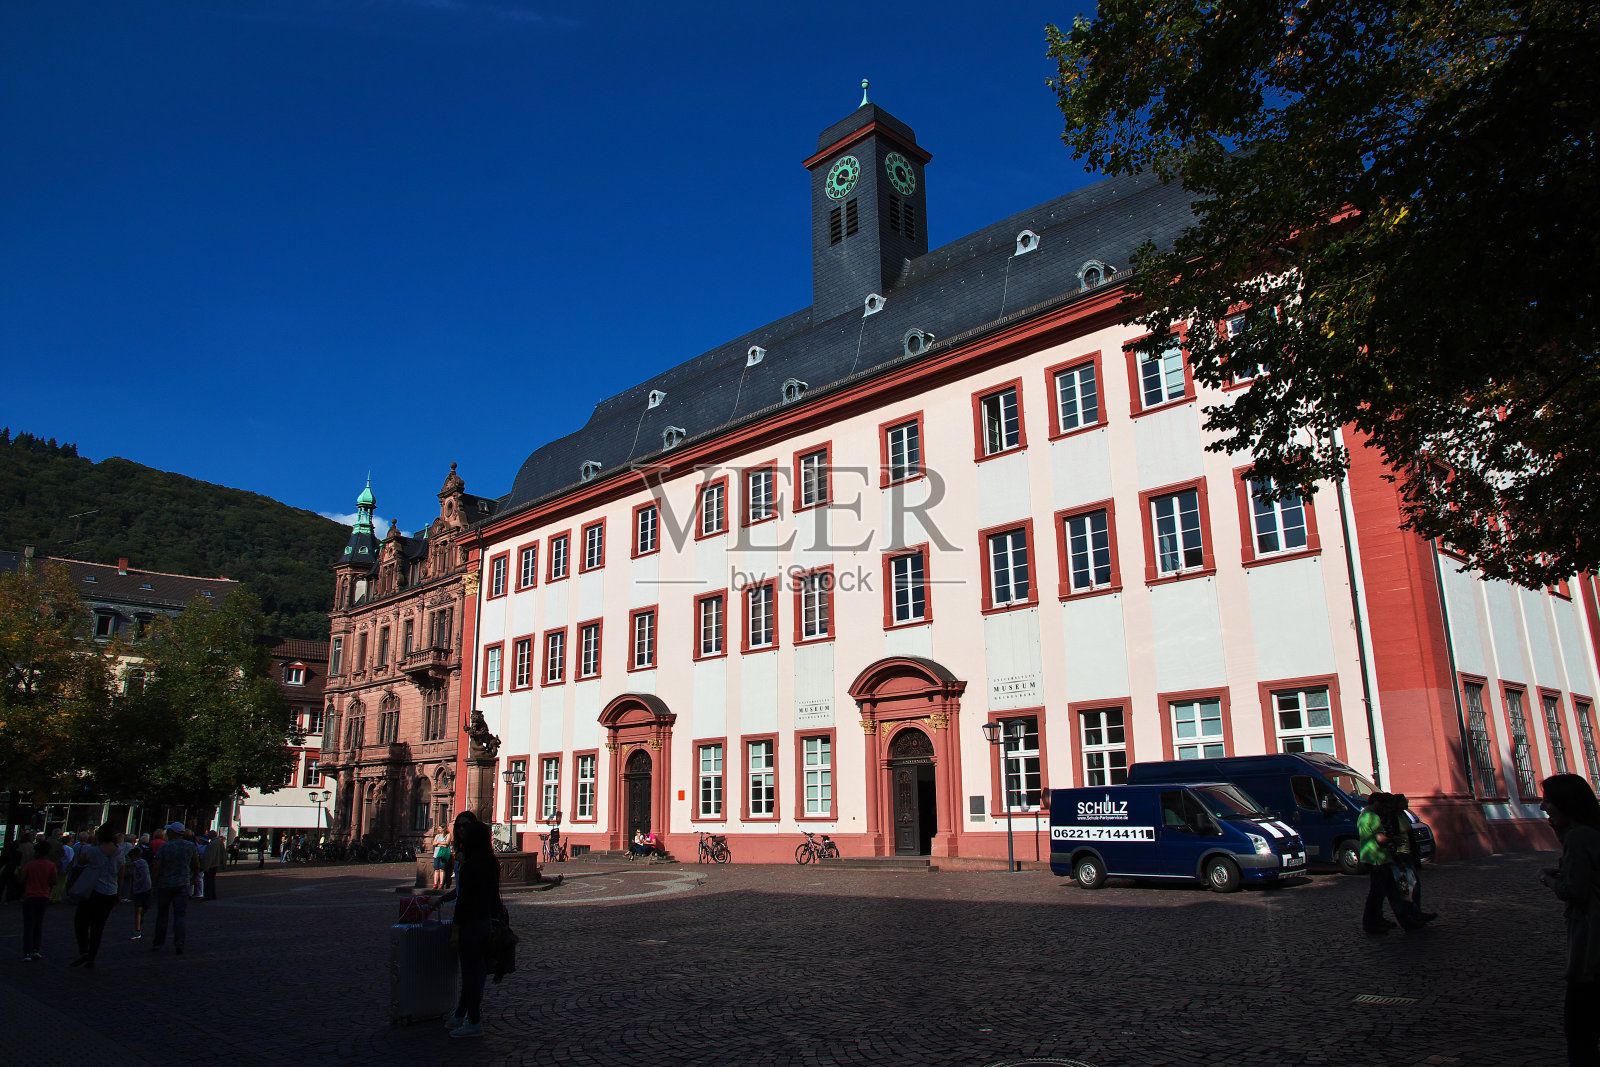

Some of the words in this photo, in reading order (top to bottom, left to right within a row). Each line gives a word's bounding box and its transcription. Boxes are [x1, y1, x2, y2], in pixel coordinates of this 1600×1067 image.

[993, 681, 1036, 693] MUSEUM
[798, 705, 830, 714] MUSEUM
[1077, 800, 1128, 814] SCHULZ
[1053, 829, 1145, 839] 06221-714411
